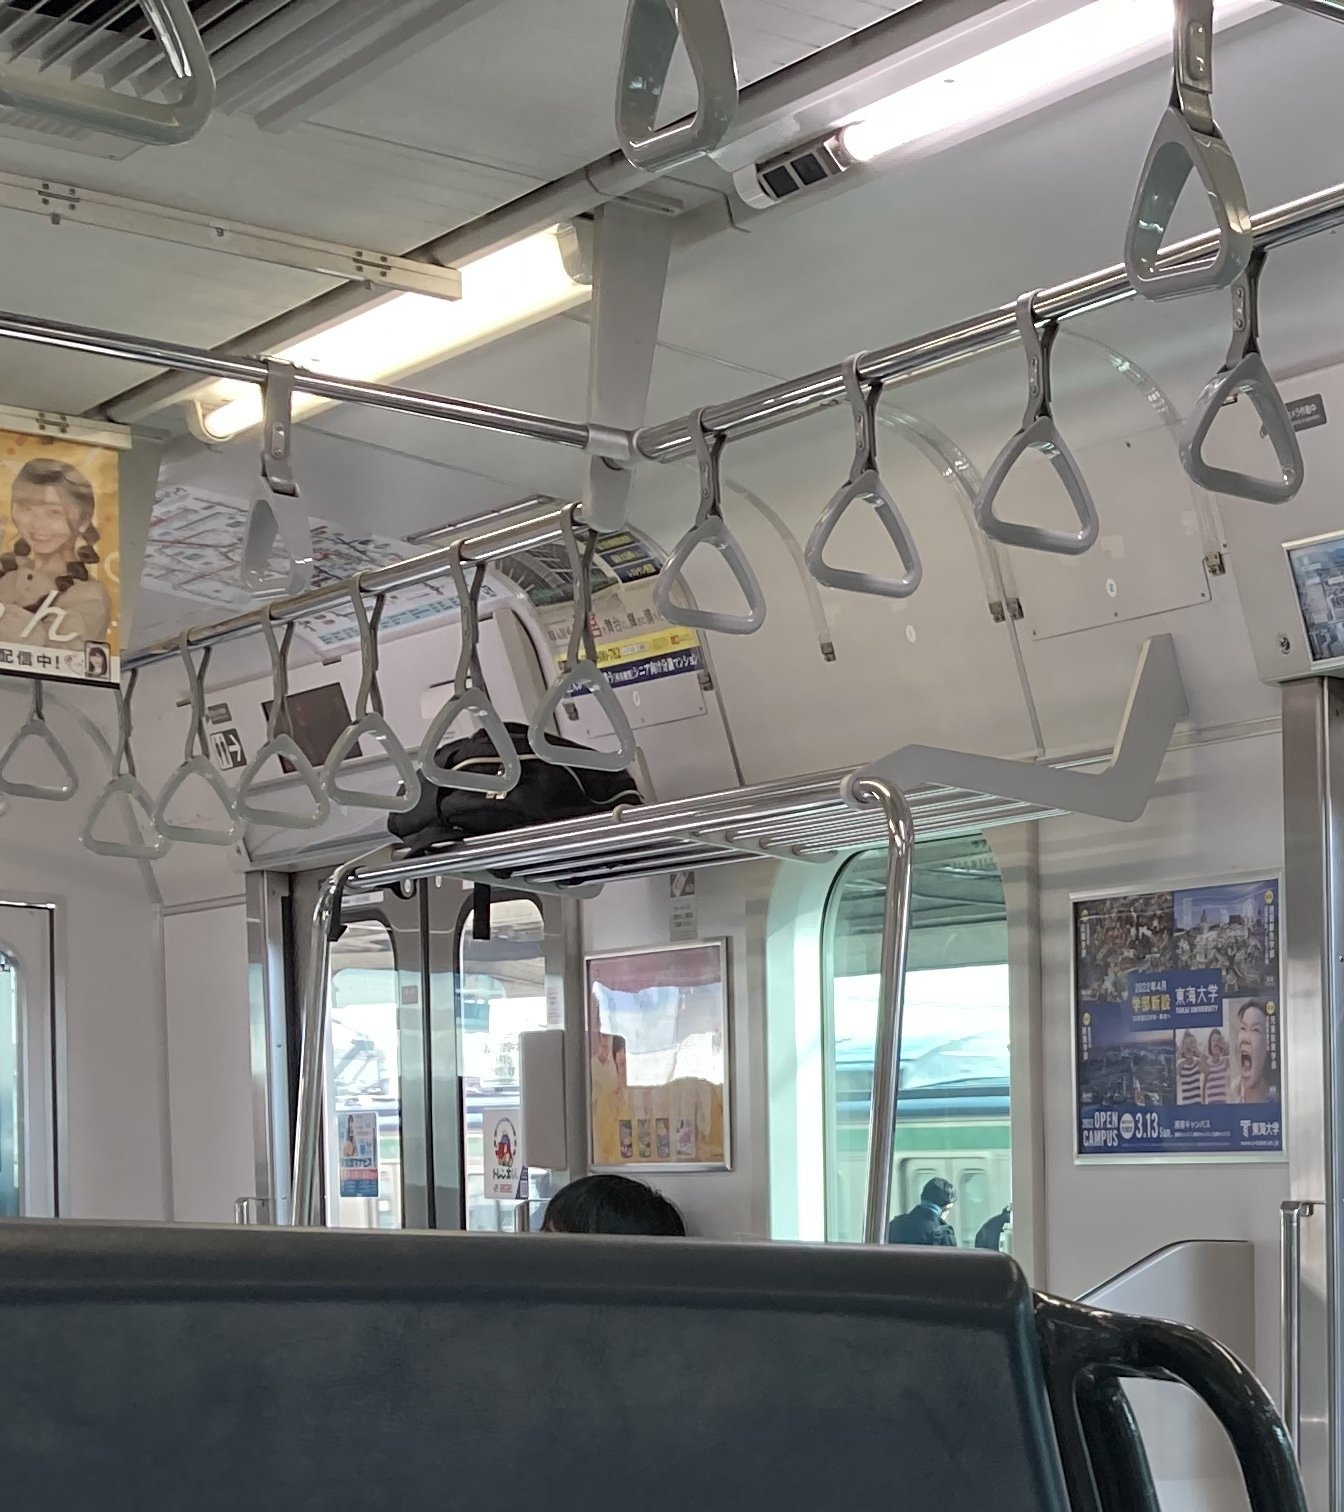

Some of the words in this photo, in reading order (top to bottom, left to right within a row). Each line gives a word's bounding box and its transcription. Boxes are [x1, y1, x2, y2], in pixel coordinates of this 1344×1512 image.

[1175, 984, 1219, 1006] 東海大学
[1094, 1111, 1119, 1129] OPEN
[1135, 1112, 1159, 1139] 3.13
[1082, 1129, 1119, 1147] CAMPUS
